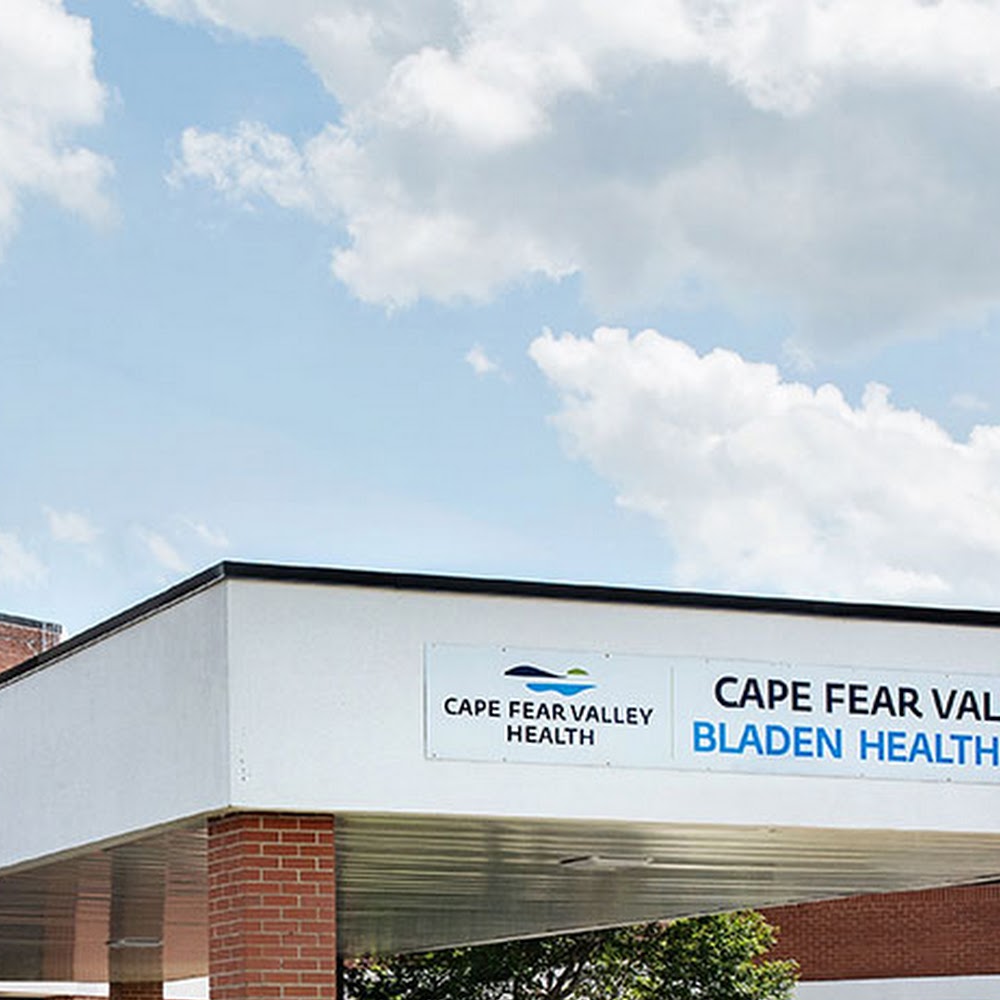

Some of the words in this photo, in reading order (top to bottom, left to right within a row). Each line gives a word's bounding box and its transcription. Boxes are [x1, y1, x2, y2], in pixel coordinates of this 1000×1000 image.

[444, 697, 501, 718] CAPE
[508, 700, 567, 721] FEAR
[570, 704, 654, 725] VALLEY
[714, 676, 813, 713] CAPE
[825, 682, 923, 719] FEAR
[931, 688, 1000, 722] VAL
[507, 725, 595, 746] HEALTH
[693, 721, 842, 759] BLADEN
[860, 729, 999, 767] HEALTH
